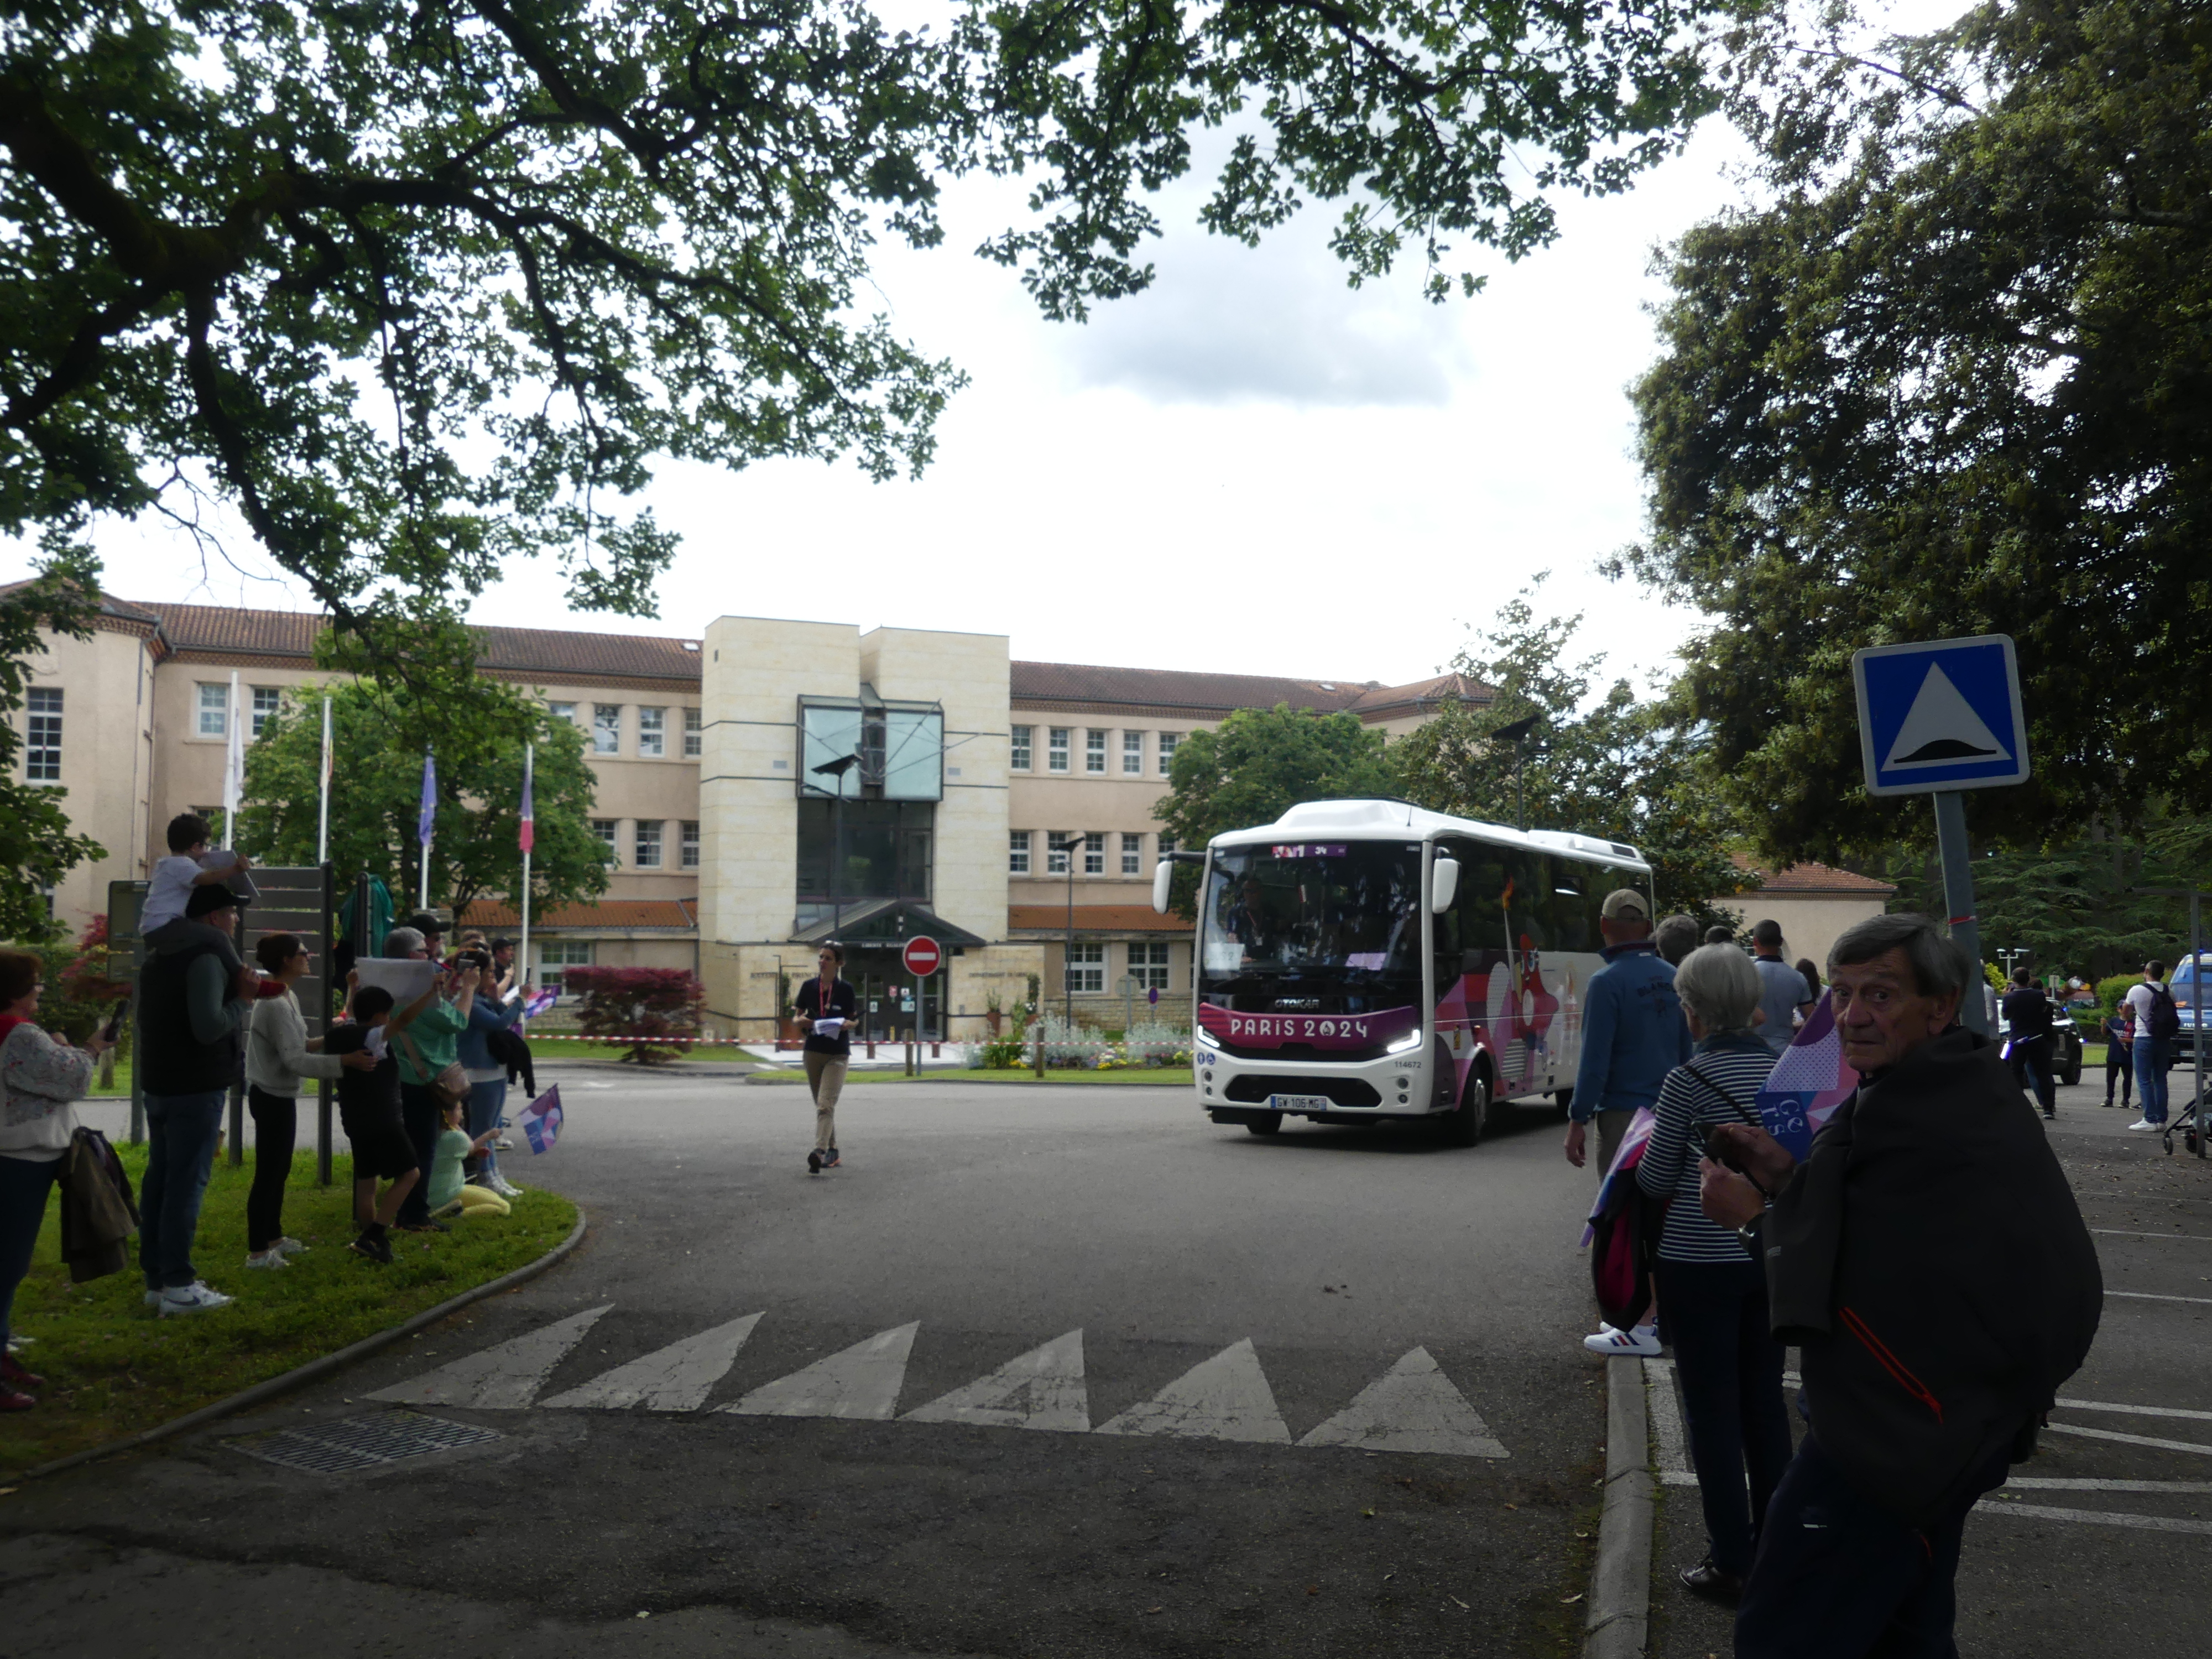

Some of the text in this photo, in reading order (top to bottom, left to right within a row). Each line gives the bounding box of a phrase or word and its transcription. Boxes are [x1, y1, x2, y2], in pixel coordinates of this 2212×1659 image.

[1275, 999, 1319, 1009] OTOKAR
[1230, 1019, 1368, 1038] PARIS 2024
